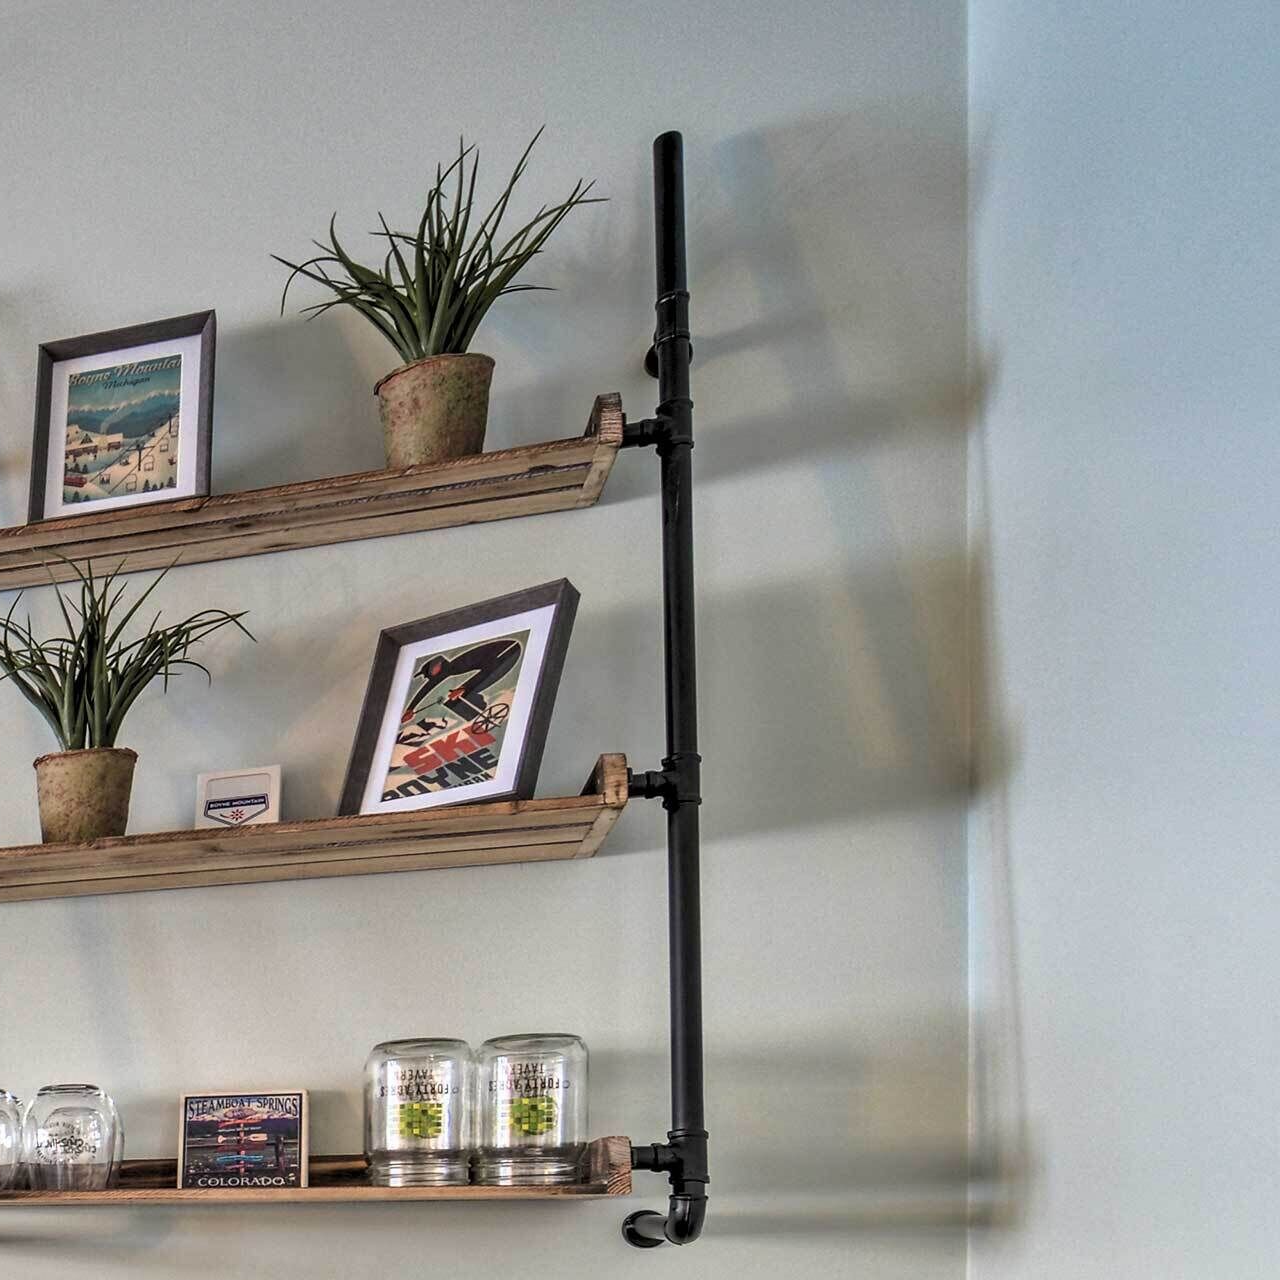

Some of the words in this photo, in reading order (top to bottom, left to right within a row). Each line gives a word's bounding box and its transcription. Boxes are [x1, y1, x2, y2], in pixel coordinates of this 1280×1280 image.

[403, 722, 497, 776] SKI
[188, 1099, 252, 1120] STEAMBOAT
[256, 1096, 299, 1117] SPRINGS
[198, 1177, 286, 1188] COLORADO
